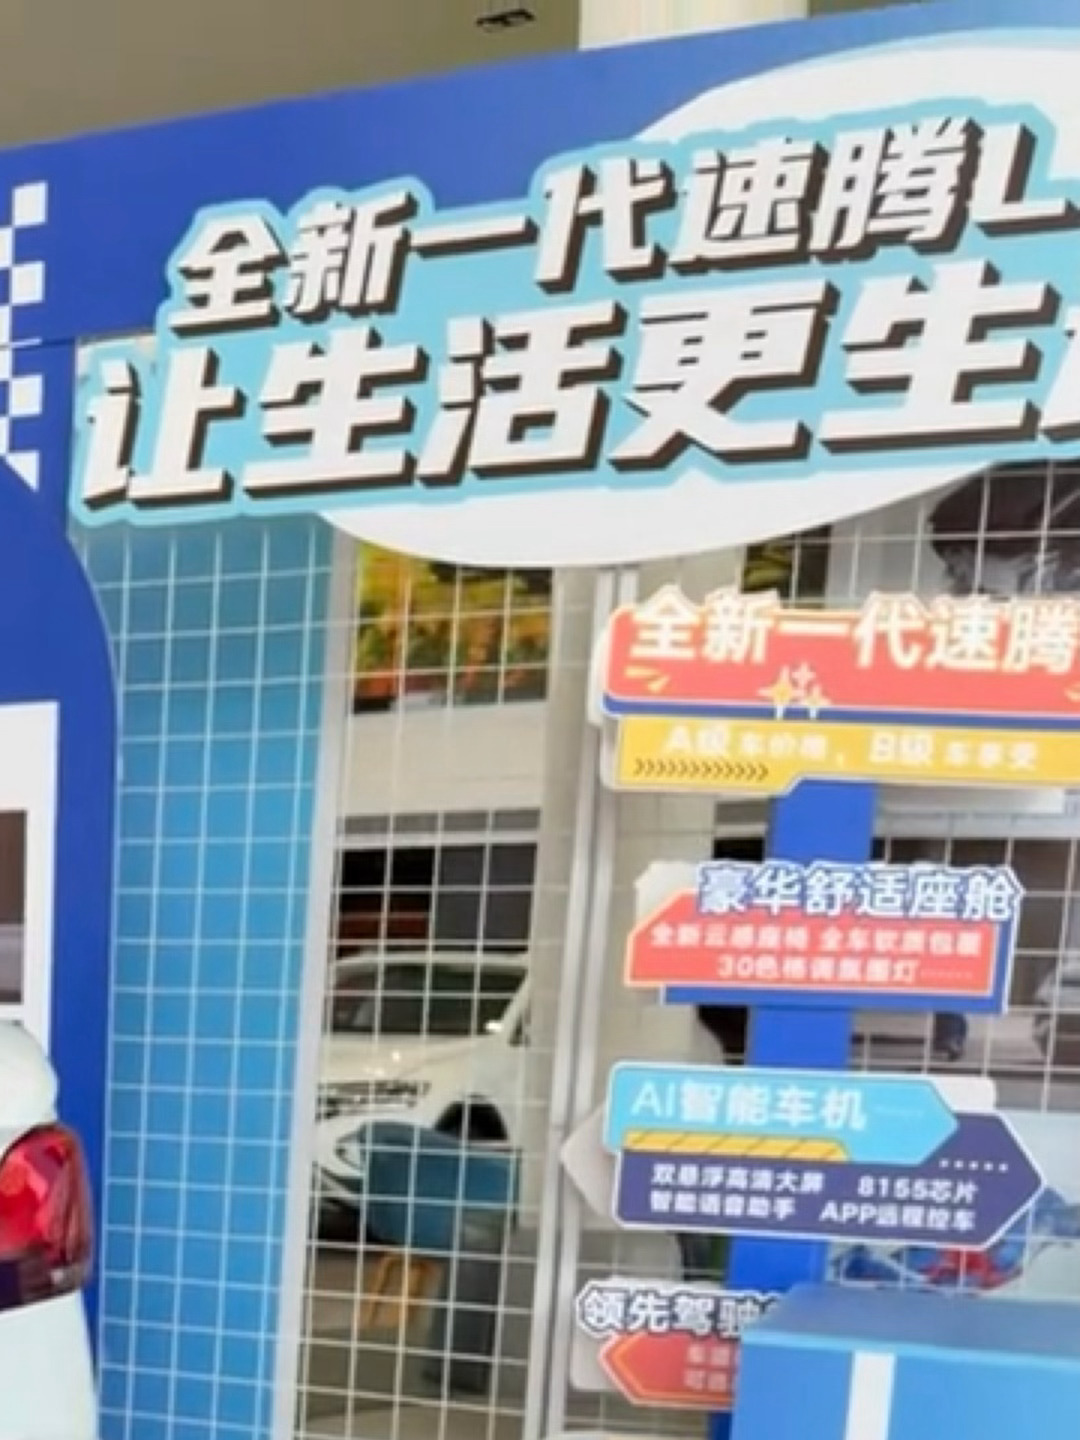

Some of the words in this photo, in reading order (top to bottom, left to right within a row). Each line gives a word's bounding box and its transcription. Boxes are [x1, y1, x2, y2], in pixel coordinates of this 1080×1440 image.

[169, 115, 1080, 336] 全新一代速腾L
[82, 258, 1080, 509] 让生活更生
[630, 586, 1080, 673] 全新一代速腾
[700, 863, 1013, 921] 豪华舒适座舱
[631, 1080, 866, 1131] AI智能车机
[650, 1189, 796, 1220] 智能语音助手
[820, 1200, 976, 1231] APP远程控车
[651, 1162, 825, 1194] 双悬浮高清大屏
[857, 1175, 978, 1203] 8155芯片
